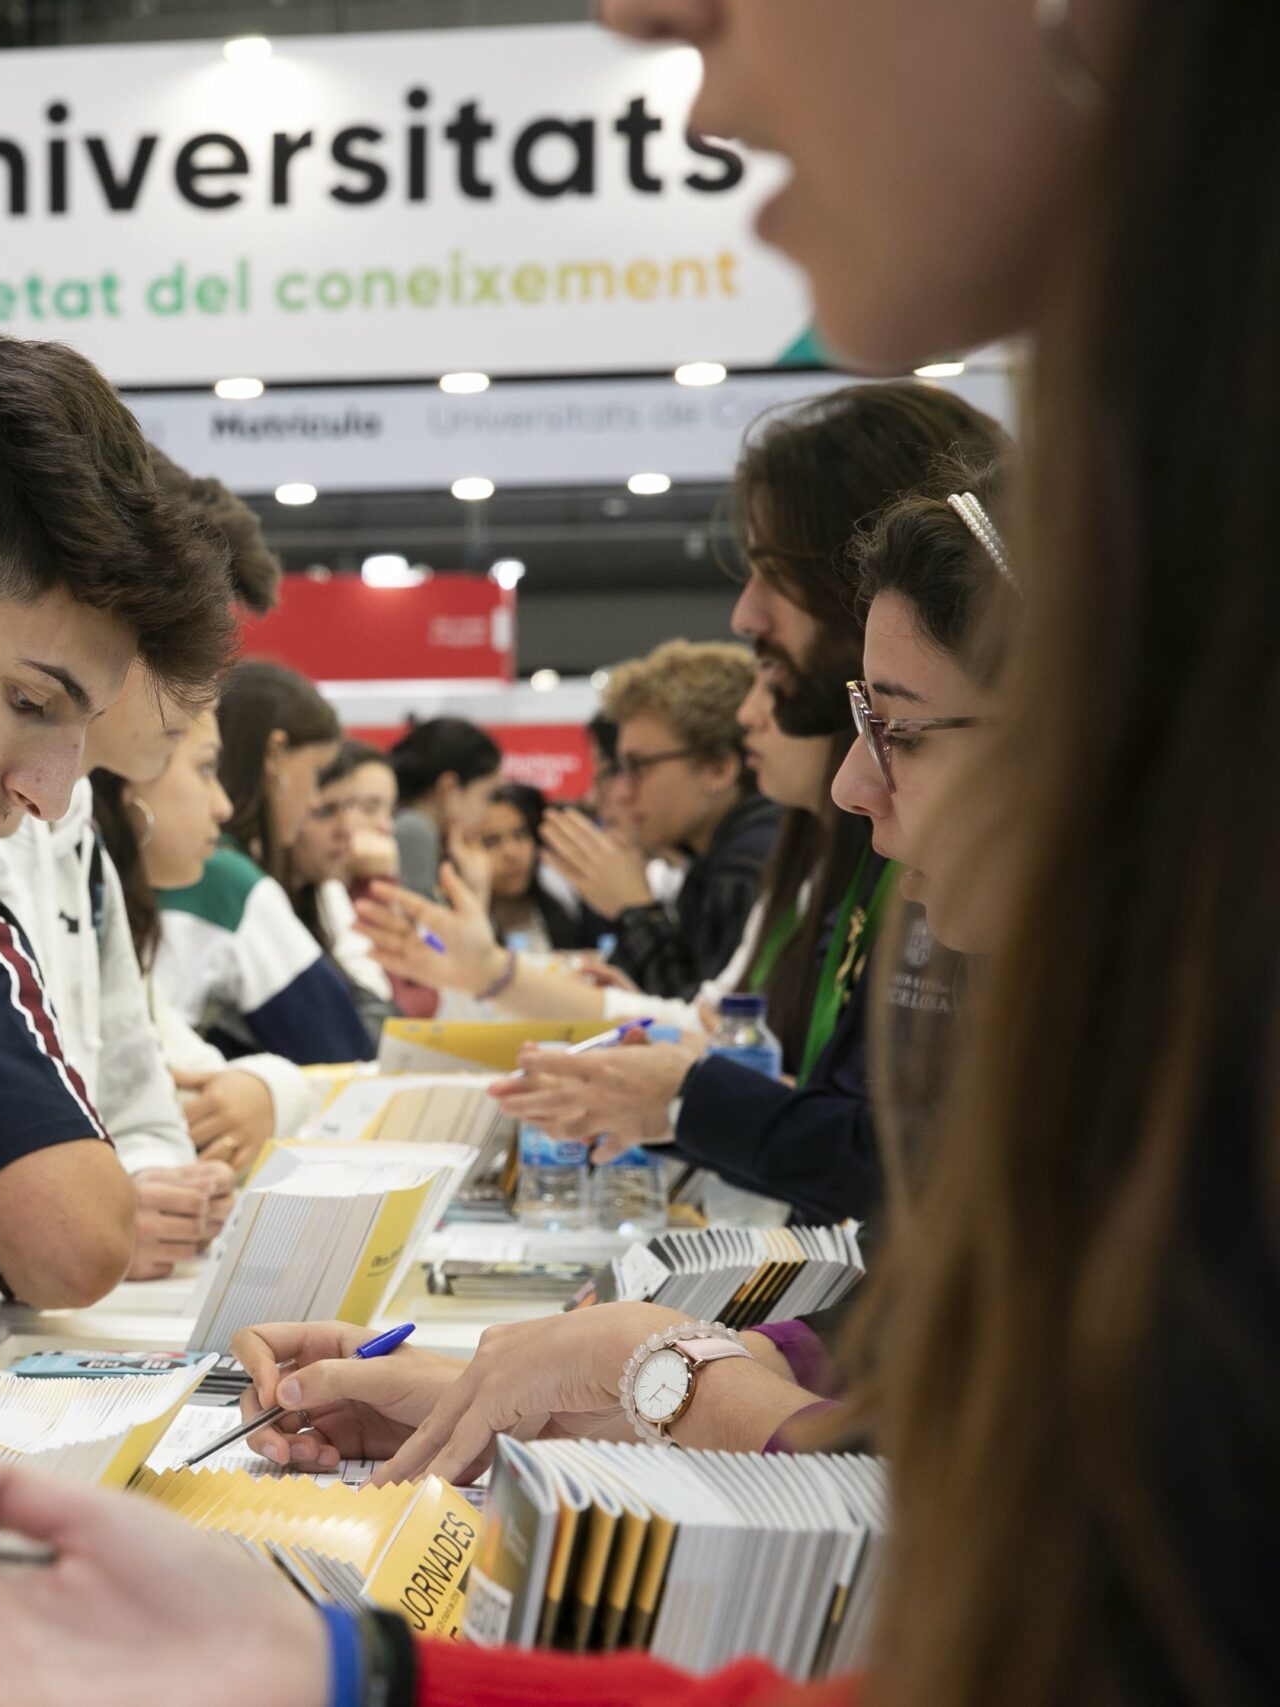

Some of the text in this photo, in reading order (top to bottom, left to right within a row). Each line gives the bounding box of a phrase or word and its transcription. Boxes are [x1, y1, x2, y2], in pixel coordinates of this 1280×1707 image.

[147, 256, 249, 316] del
[274, 250, 739, 312] coneixement
[399, 1511, 476, 1631] JORNADES
